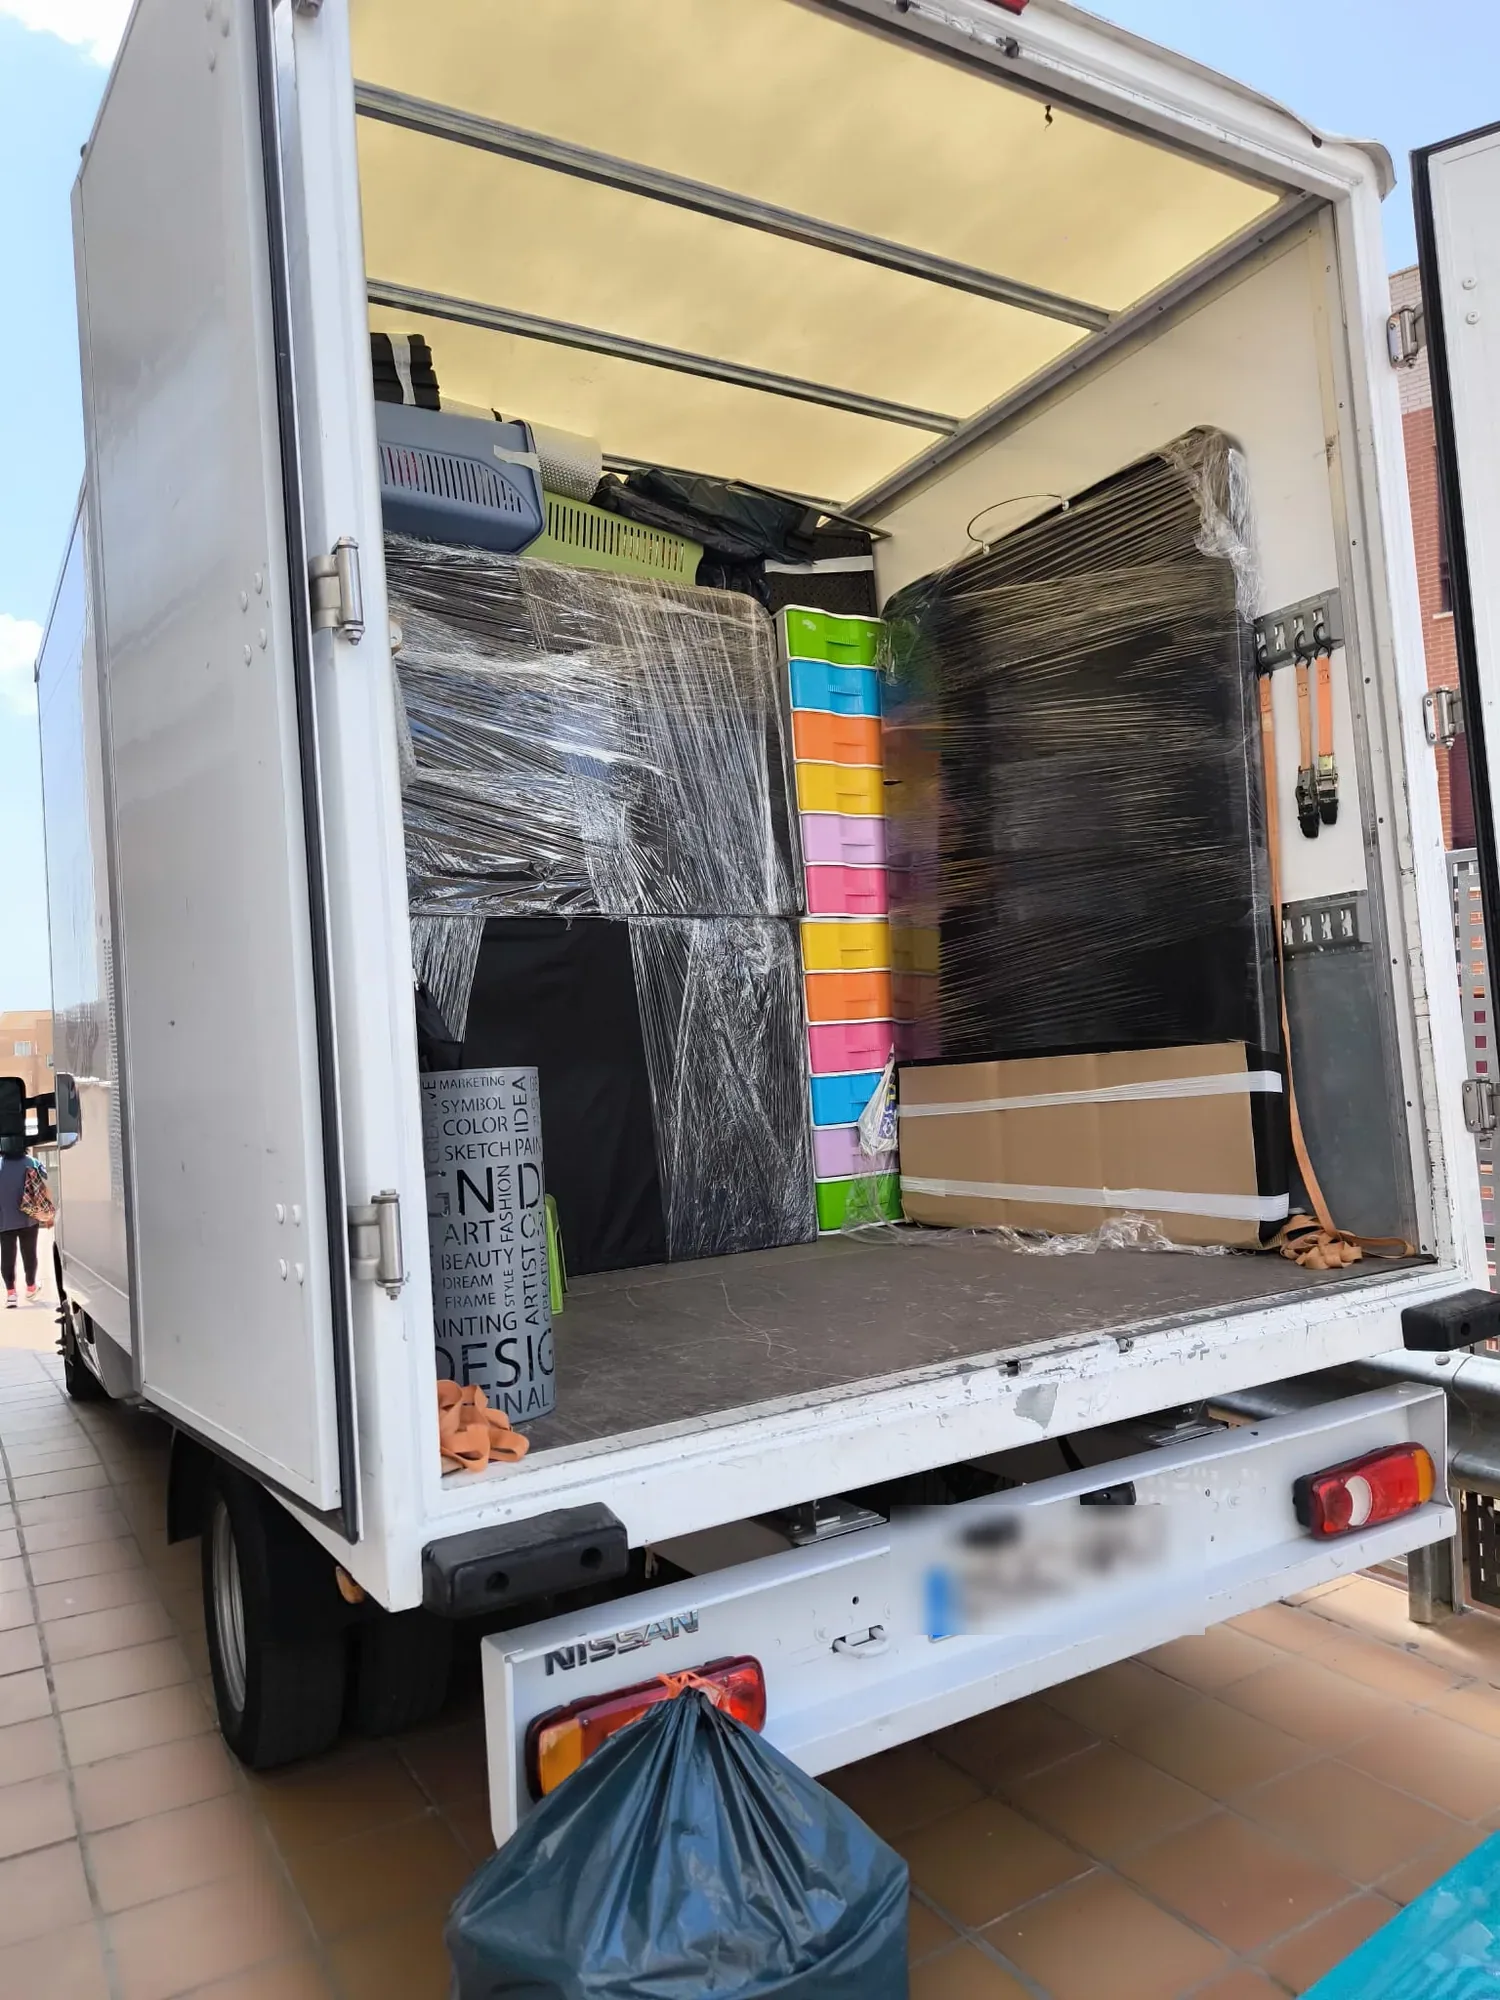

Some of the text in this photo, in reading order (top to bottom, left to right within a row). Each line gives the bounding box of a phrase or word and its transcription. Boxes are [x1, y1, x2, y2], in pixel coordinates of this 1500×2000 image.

[439, 1076, 505, 1090] MARKETING
[441, 1097, 506, 1114] SYMBOL
[512, 1075, 528, 1133] IDEA
[443, 1116, 508, 1136] COLOR
[445, 1141, 511, 1162] SKETCH
[496, 1164, 514, 1242] FASHION
[444, 1219, 496, 1246] ART
[441, 1247, 514, 1271] BEAUTY
[443, 1273, 493, 1290] DREAM
[503, 1269, 516, 1308] STYLE
[521, 1244, 540, 1326] ARTIST
[445, 1292, 496, 1309] FRAME
[544, 1609, 700, 1676] NISSAN
